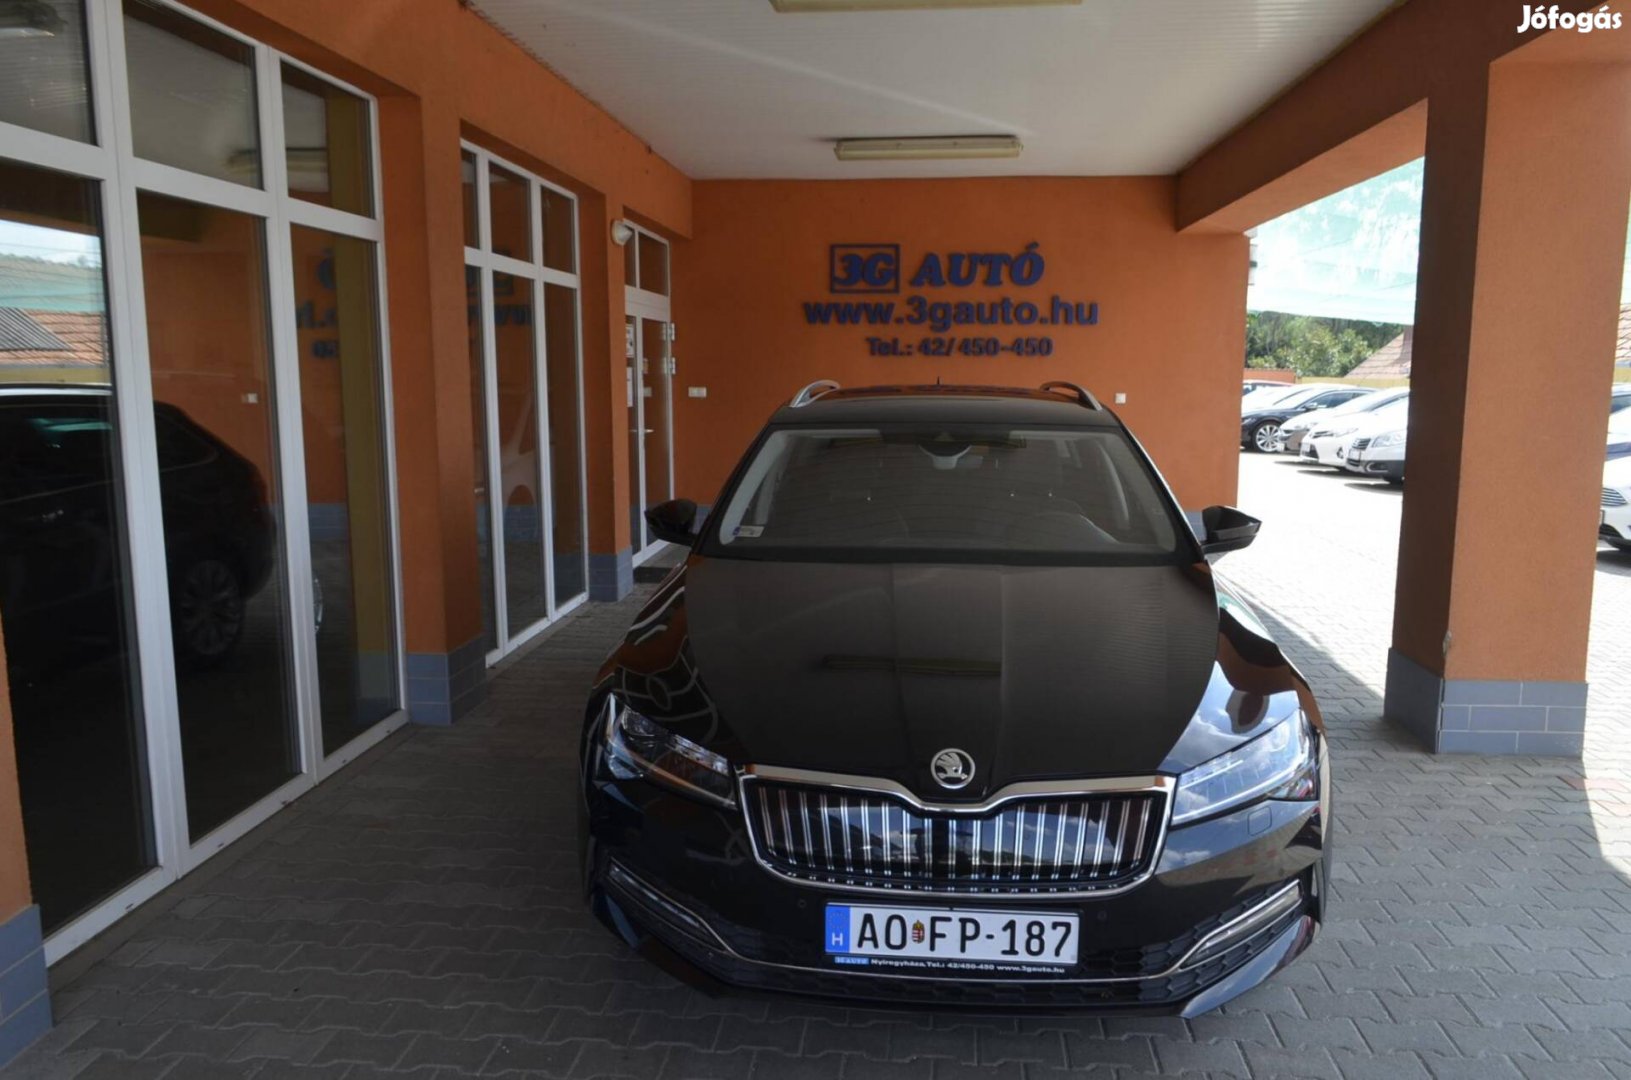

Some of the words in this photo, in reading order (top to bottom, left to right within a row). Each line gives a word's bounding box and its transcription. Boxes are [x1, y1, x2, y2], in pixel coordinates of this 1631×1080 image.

[833, 253, 895, 286] 3G
[909, 242, 1045, 287] AUTÓ
[803, 295, 1098, 332] www.3gauto.hu
[831, 932, 844, 946] H
